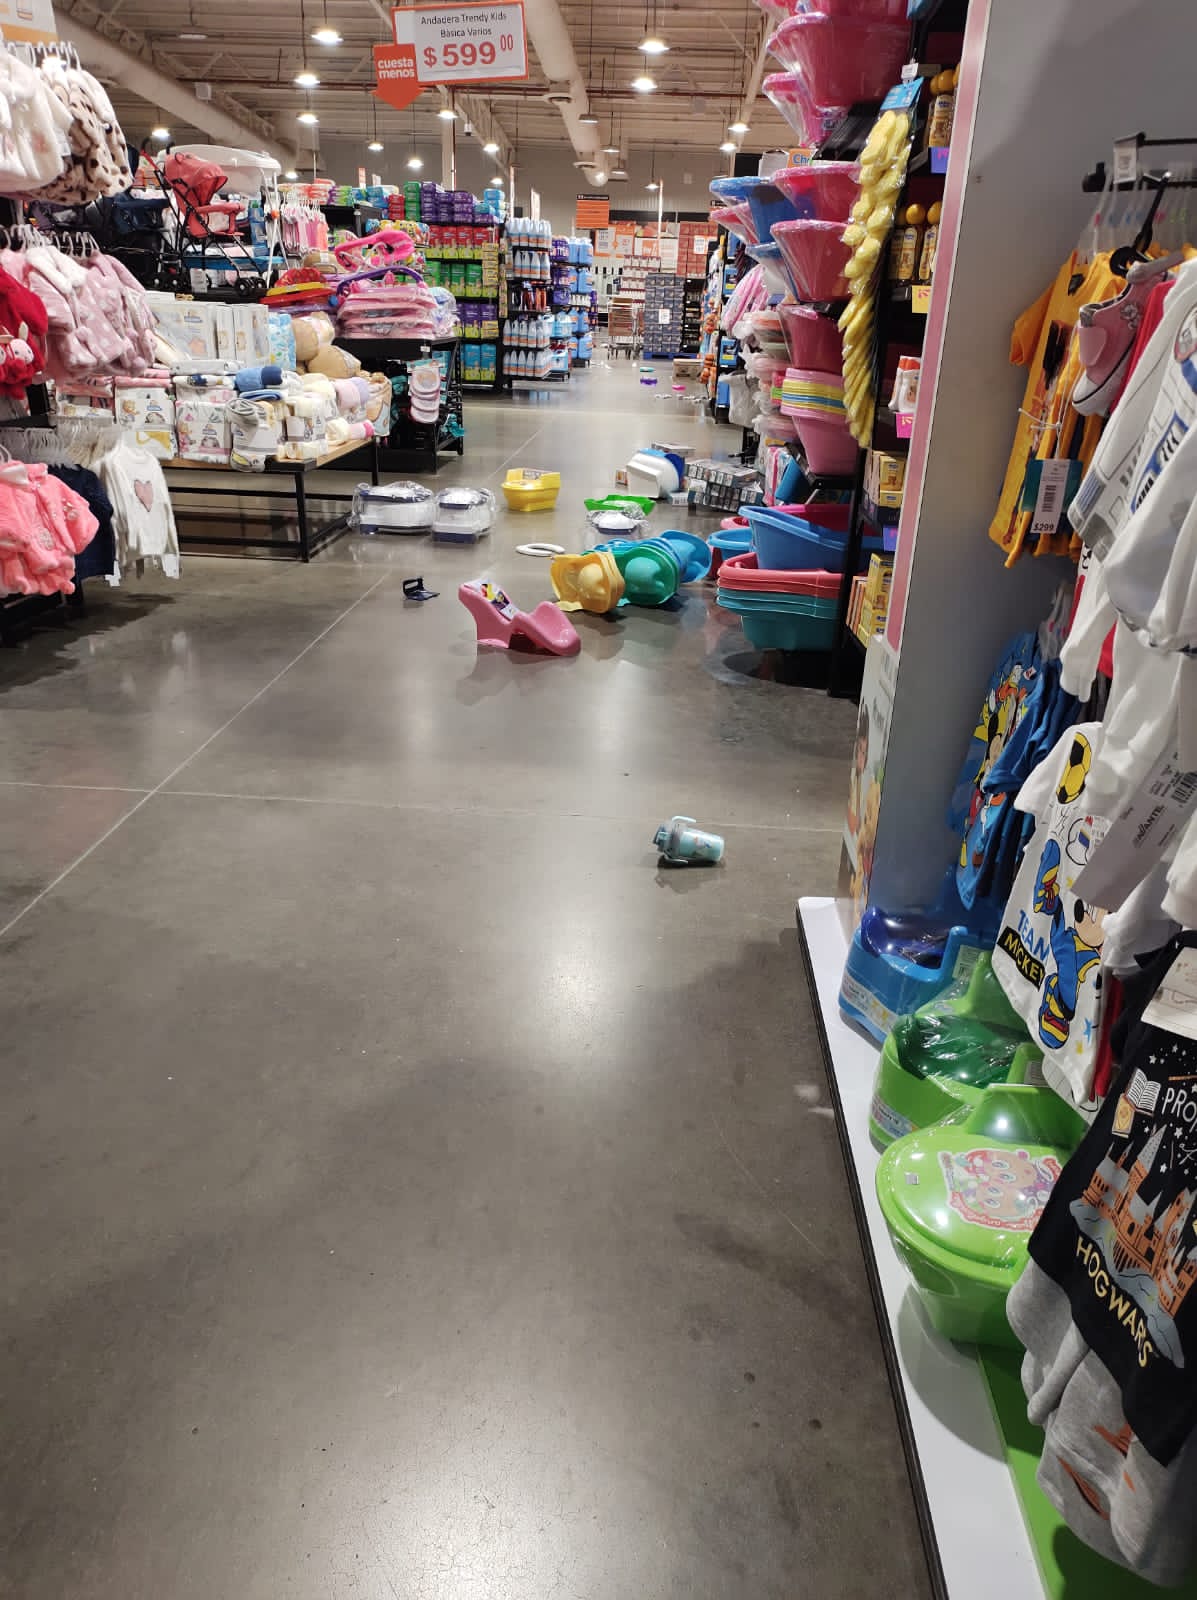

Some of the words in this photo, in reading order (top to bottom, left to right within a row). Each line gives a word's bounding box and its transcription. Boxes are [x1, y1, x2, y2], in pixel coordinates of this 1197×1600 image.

[421, 14, 460, 25] Andadera
[461, 11, 489, 23] Trendy
[490, 10, 507, 20] Kids
[467, 27, 492, 36] Varios
[500, 34, 514, 51] 00
[378, 58, 414, 69] cuesta
[379, 69, 415, 79] menos
[1017, 909, 1050, 962] TEAM
